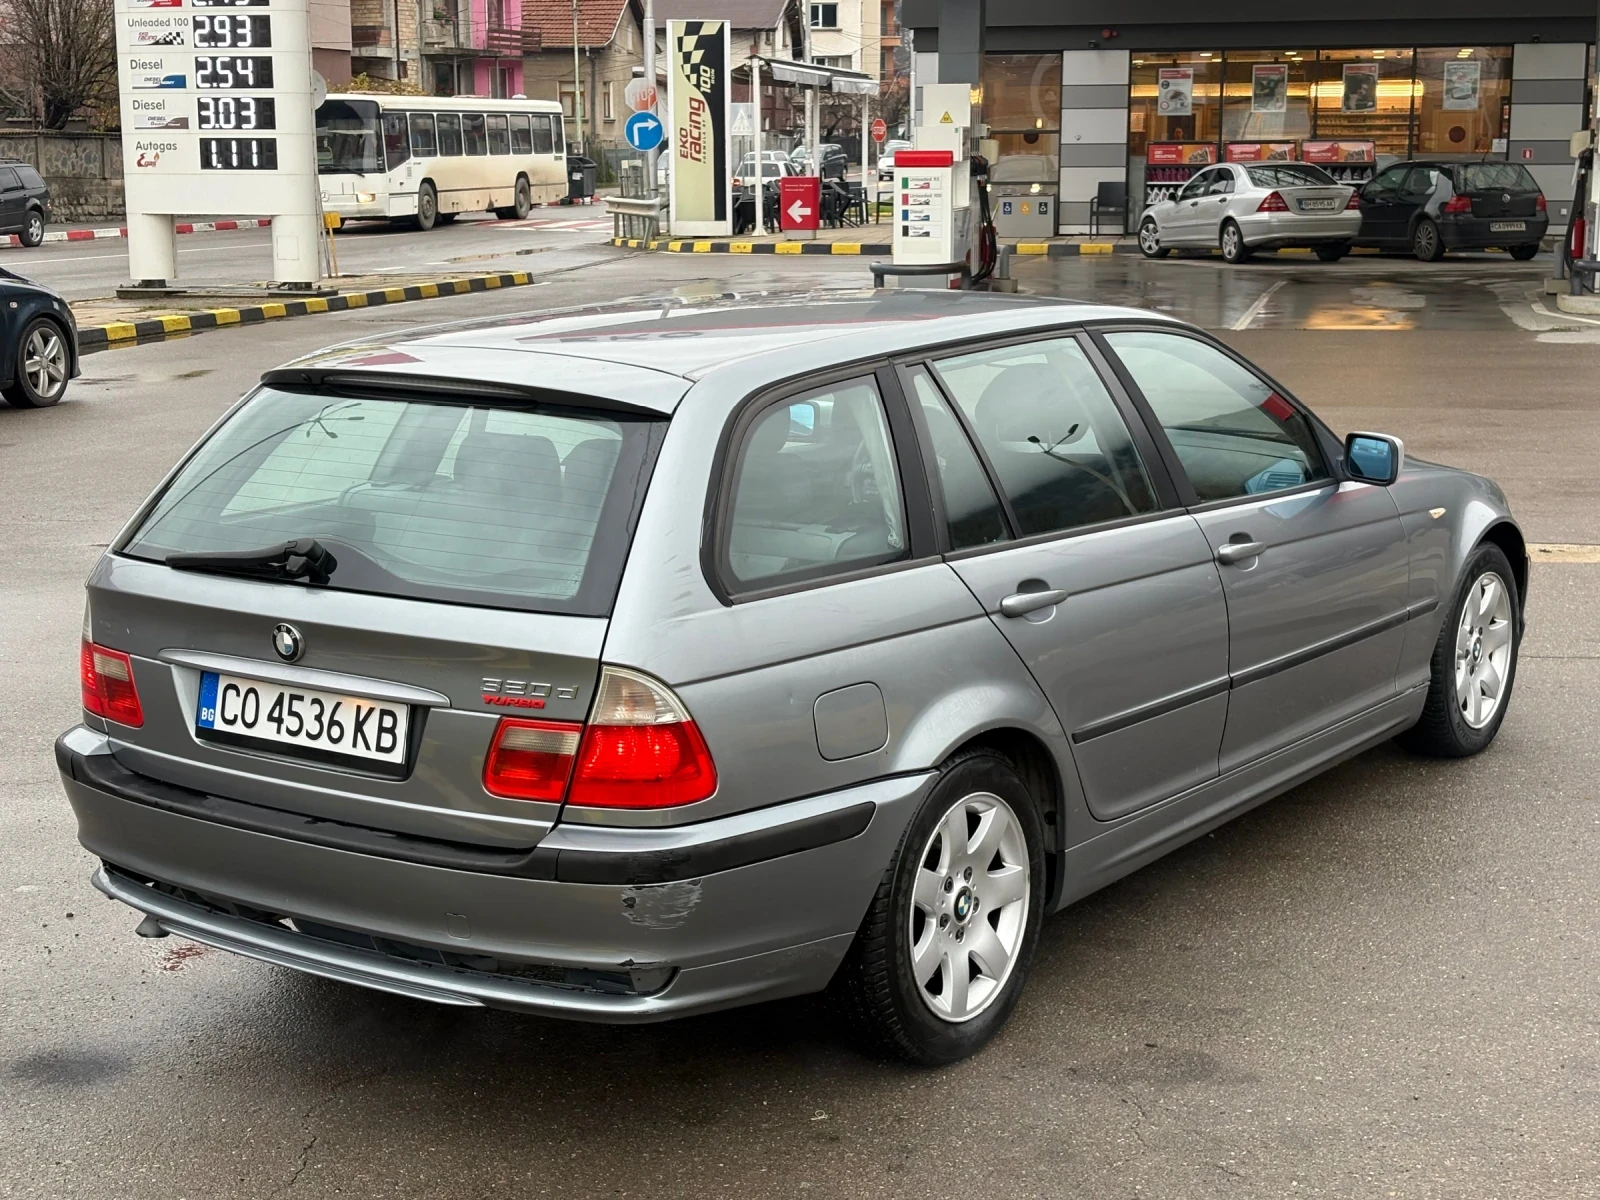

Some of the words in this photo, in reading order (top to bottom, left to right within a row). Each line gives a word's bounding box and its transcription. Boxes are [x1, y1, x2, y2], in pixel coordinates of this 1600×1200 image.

[128, 18, 170, 27] Unleaded
[173, 18, 188, 26] 100
[194, 15, 252, 48] 2.93
[130, 59, 163, 69] Diesel
[196, 56, 254, 88] 2.54
[700, 65, 711, 93] 100
[132, 99, 165, 110] Diesel
[199, 97, 256, 129] 3.03
[689, 97, 705, 163] racing
[873, 126, 885, 135] STOP
[135, 141, 177, 152] Autogas
[680, 127, 688, 159] EKO
[273, 625, 297, 639] BMW
[481, 694, 546, 710] TURBO
[201, 707, 215, 722] BG
[220, 683, 260, 729] CO
[266, 692, 345, 745] 4536
[351, 704, 398, 754] KB
